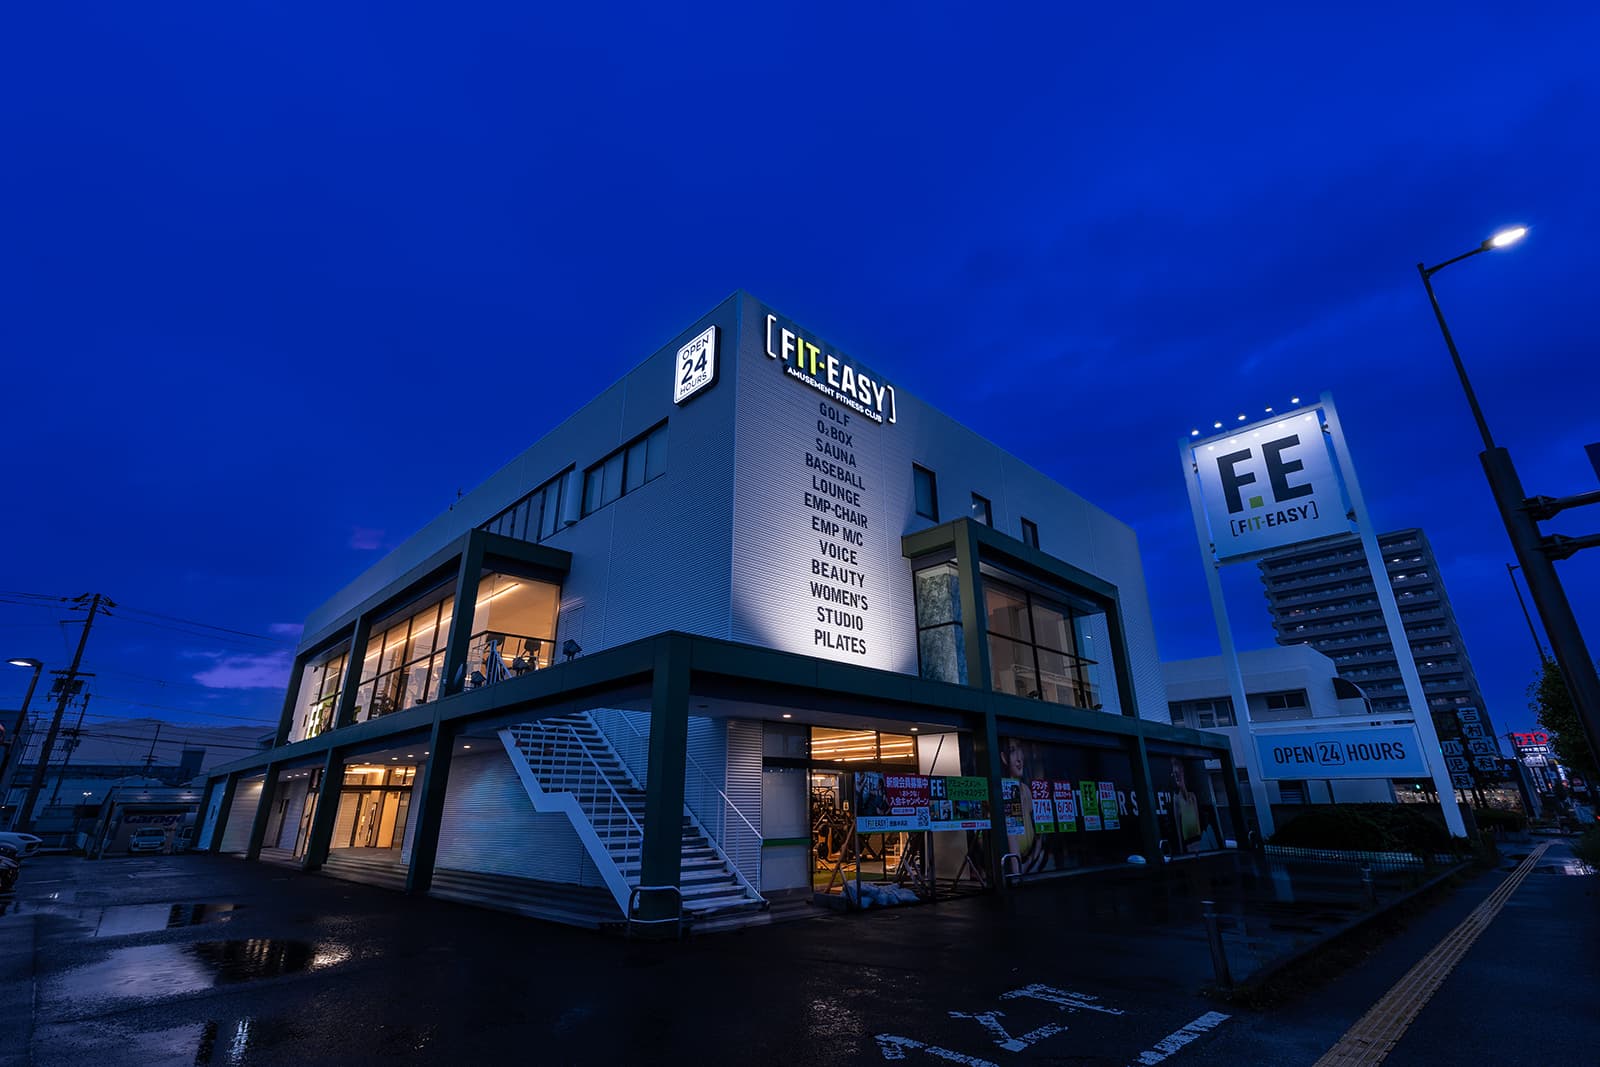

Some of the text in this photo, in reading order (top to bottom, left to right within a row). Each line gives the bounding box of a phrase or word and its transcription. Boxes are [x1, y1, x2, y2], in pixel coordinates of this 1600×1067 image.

[682, 334, 709, 360] OPEN
[681, 348, 708, 385] 24
[680, 371, 708, 396] HOURS
[787, 367, 883, 423] AMUSEMENT FITNESS CLUB
[819, 402, 851, 427] GOLF
[815, 438, 857, 468] SAUNA
[805, 452, 866, 491] BASEBALL
[812, 475, 861, 508] LOUNGE
[804, 492, 868, 529] EMP-CHAIR
[811, 515, 864, 547] EMP M/C
[819, 539, 858, 566] VOICE
[811, 558, 866, 588] BEAUTY
[810, 580, 869, 611] WOMEN'S
[817, 606, 864, 631] STUDIO
[814, 629, 867, 655] PILATES
[1273, 742, 1406, 764] OPEN 24 HOURS
[1460, 709, 1493, 771] 吉村内科
[1445, 742, 1471, 787] 小児科
